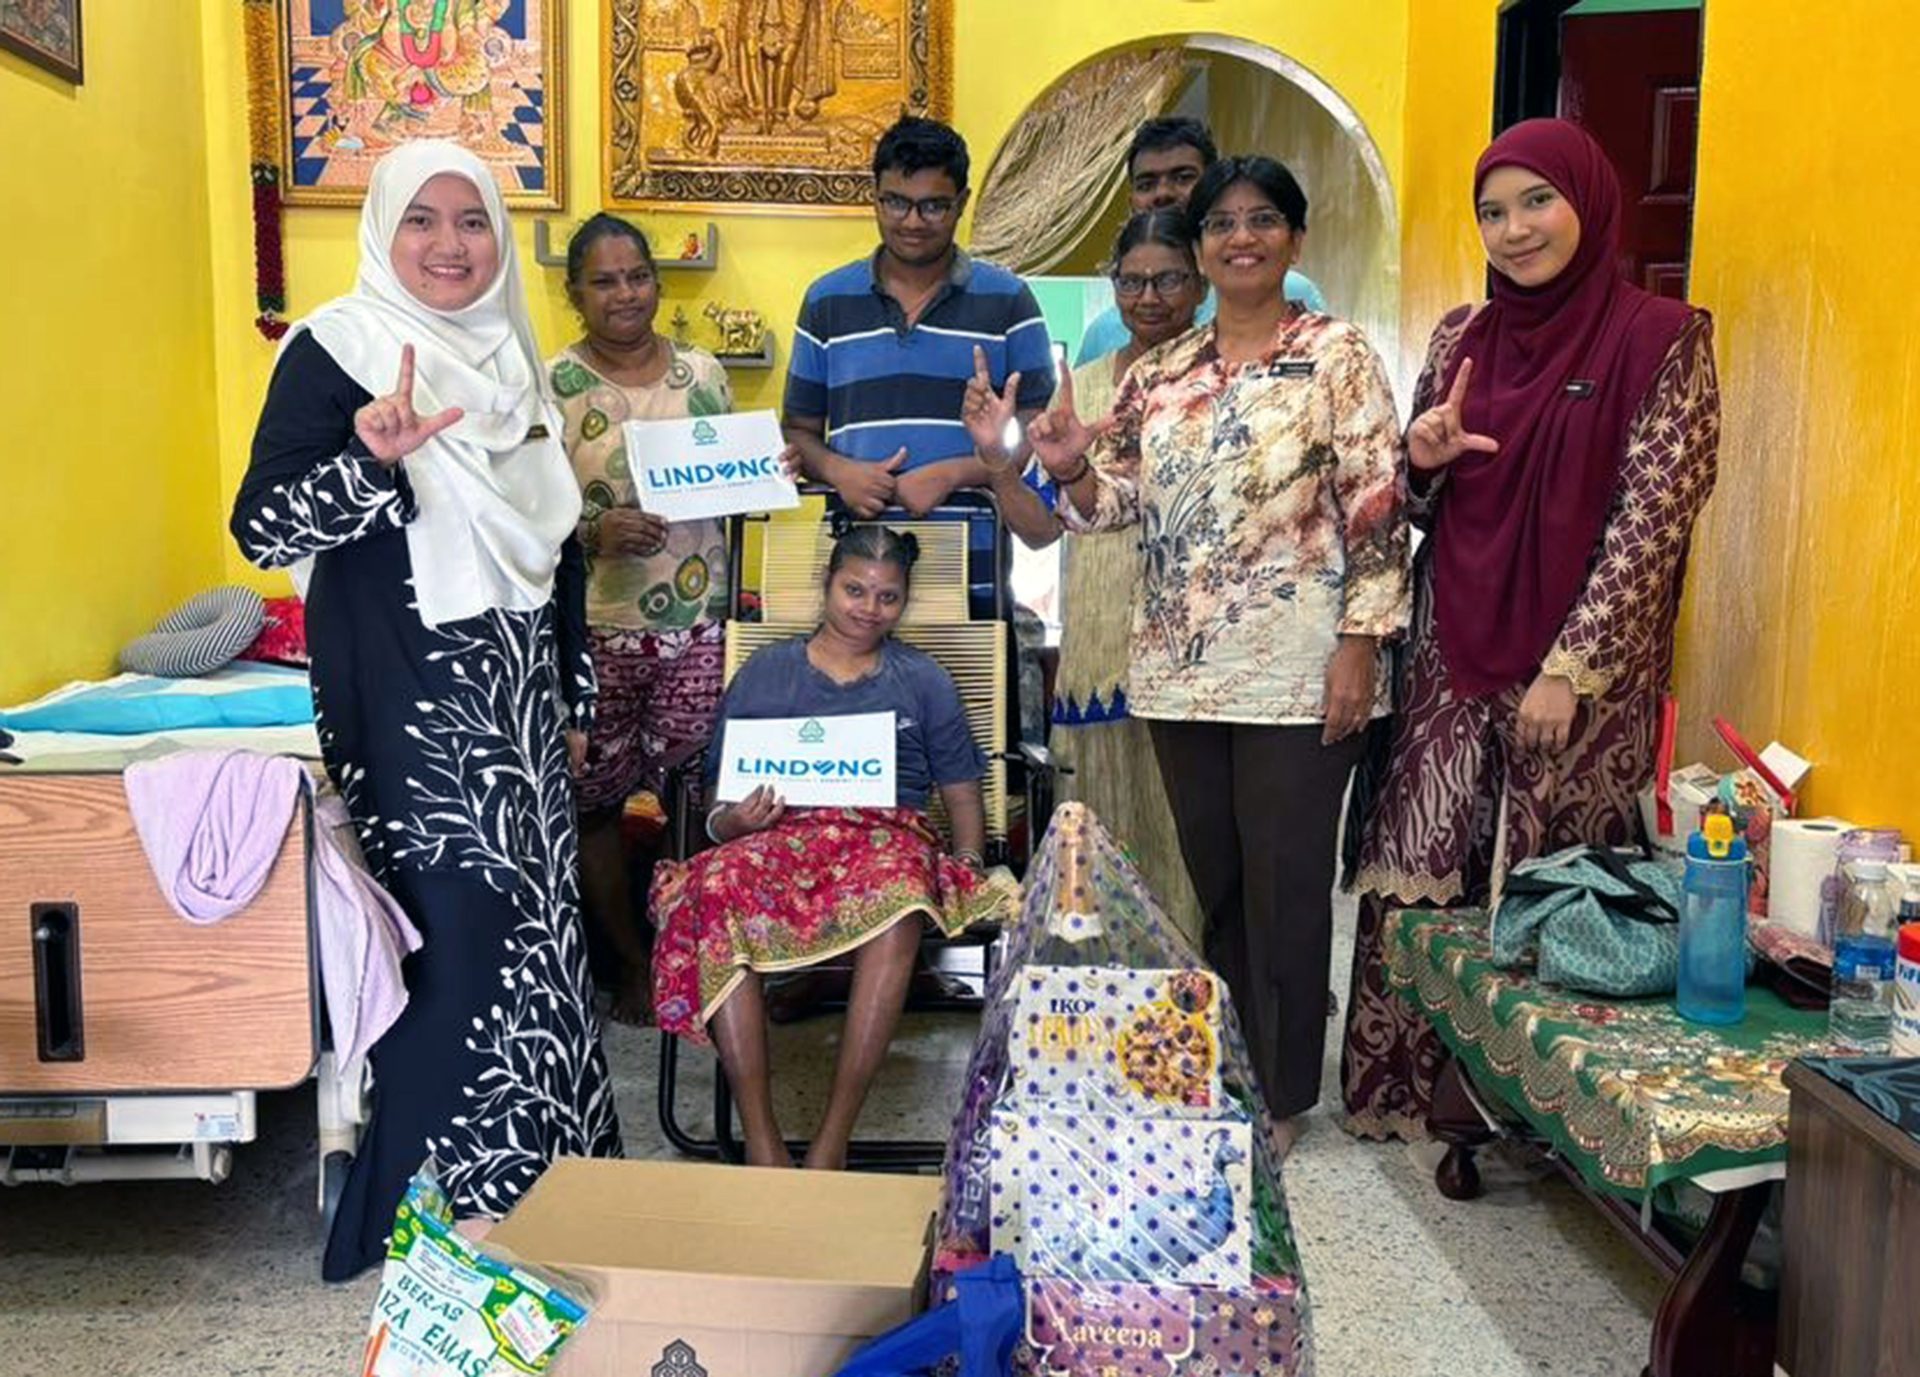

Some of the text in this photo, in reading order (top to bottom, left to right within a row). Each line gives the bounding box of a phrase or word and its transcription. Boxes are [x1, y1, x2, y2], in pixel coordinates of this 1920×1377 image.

[397, 1274, 463, 1321] BERAS
[378, 1289, 411, 1330] IZA
[421, 1322, 489, 1377] EMAS
